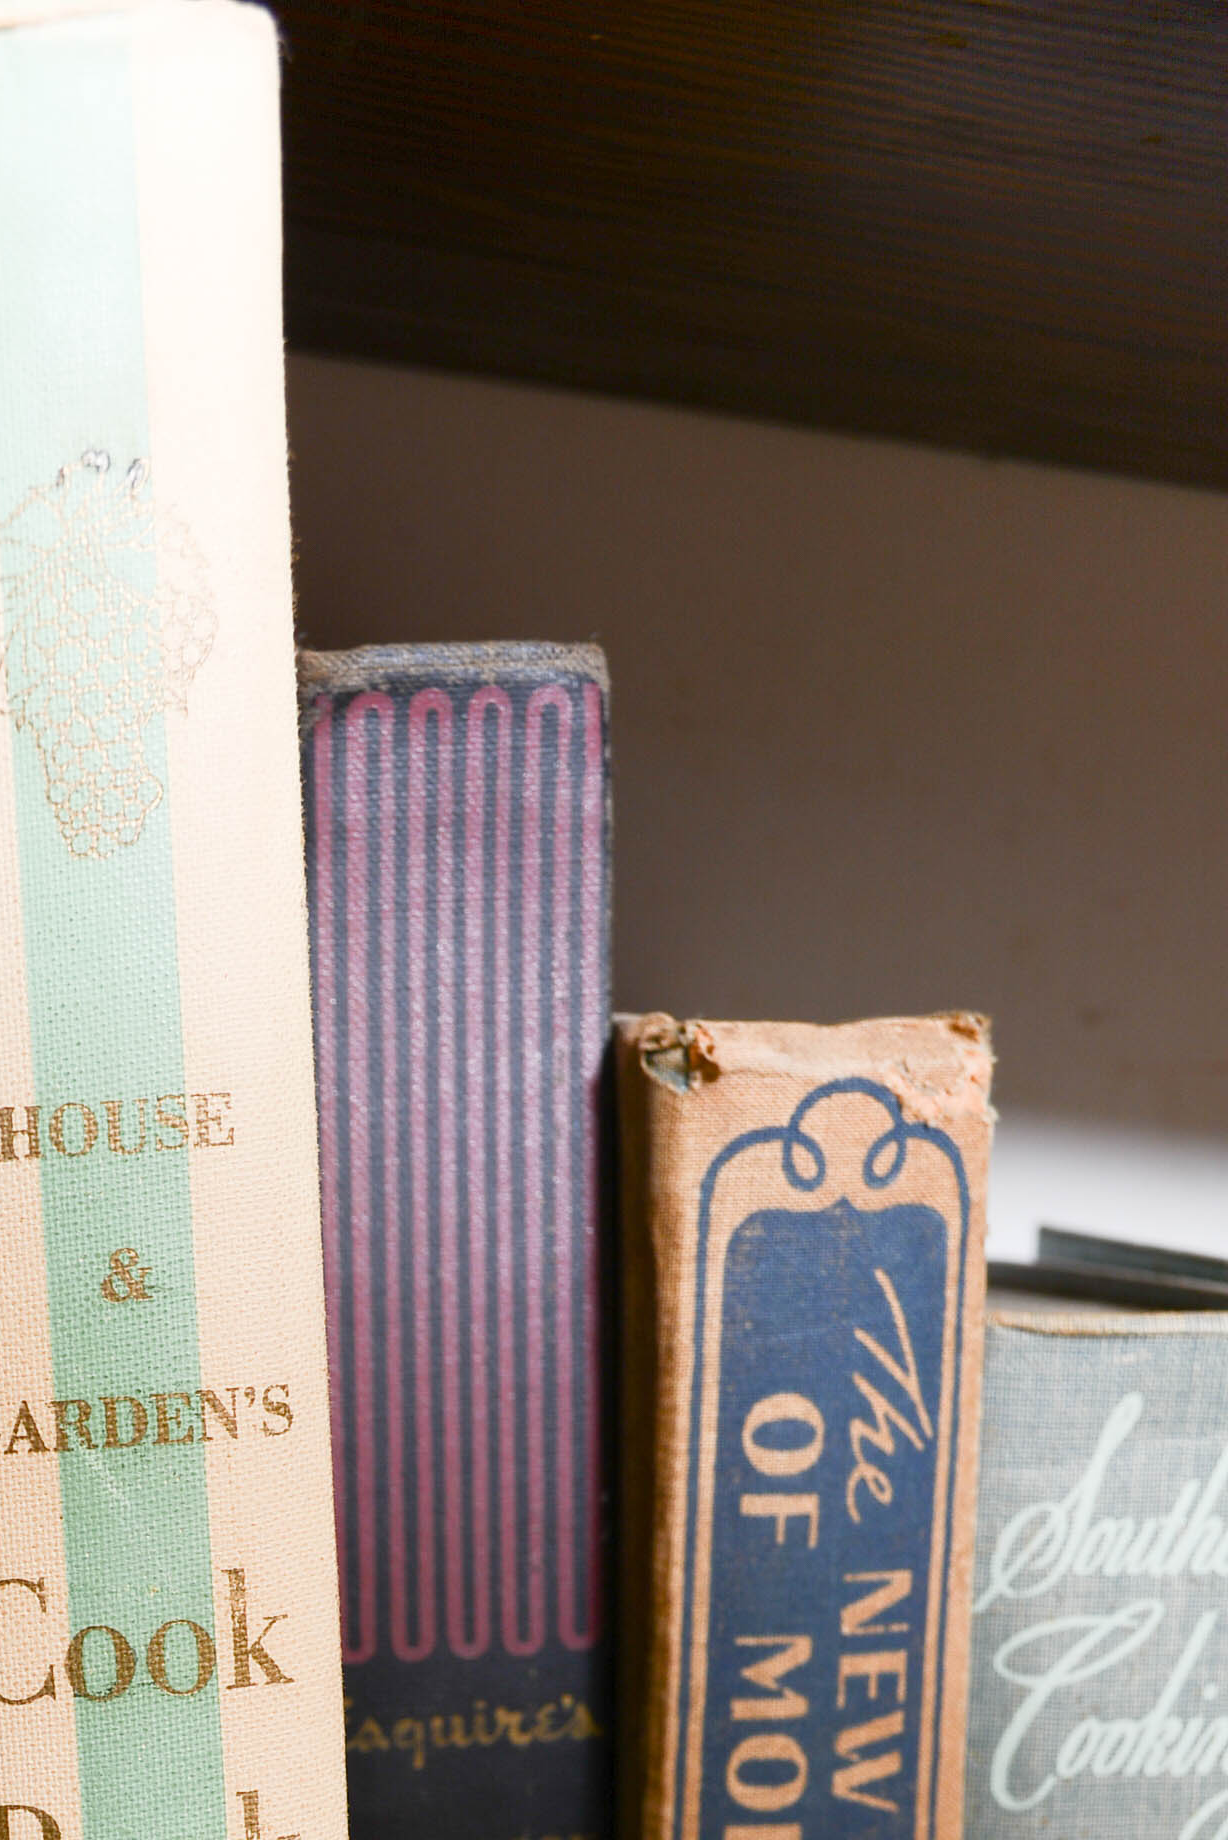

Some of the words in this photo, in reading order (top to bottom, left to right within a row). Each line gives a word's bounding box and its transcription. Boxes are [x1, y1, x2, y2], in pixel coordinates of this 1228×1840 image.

[100, 1246, 155, 1305] &
[738, 1392, 826, 1550] OF
[844, 1266, 934, 1525] The
[972, 1391, 1228, 1614] South
[344, 1693, 605, 1770] squire's
[830, 1567, 915, 1813] NEW
